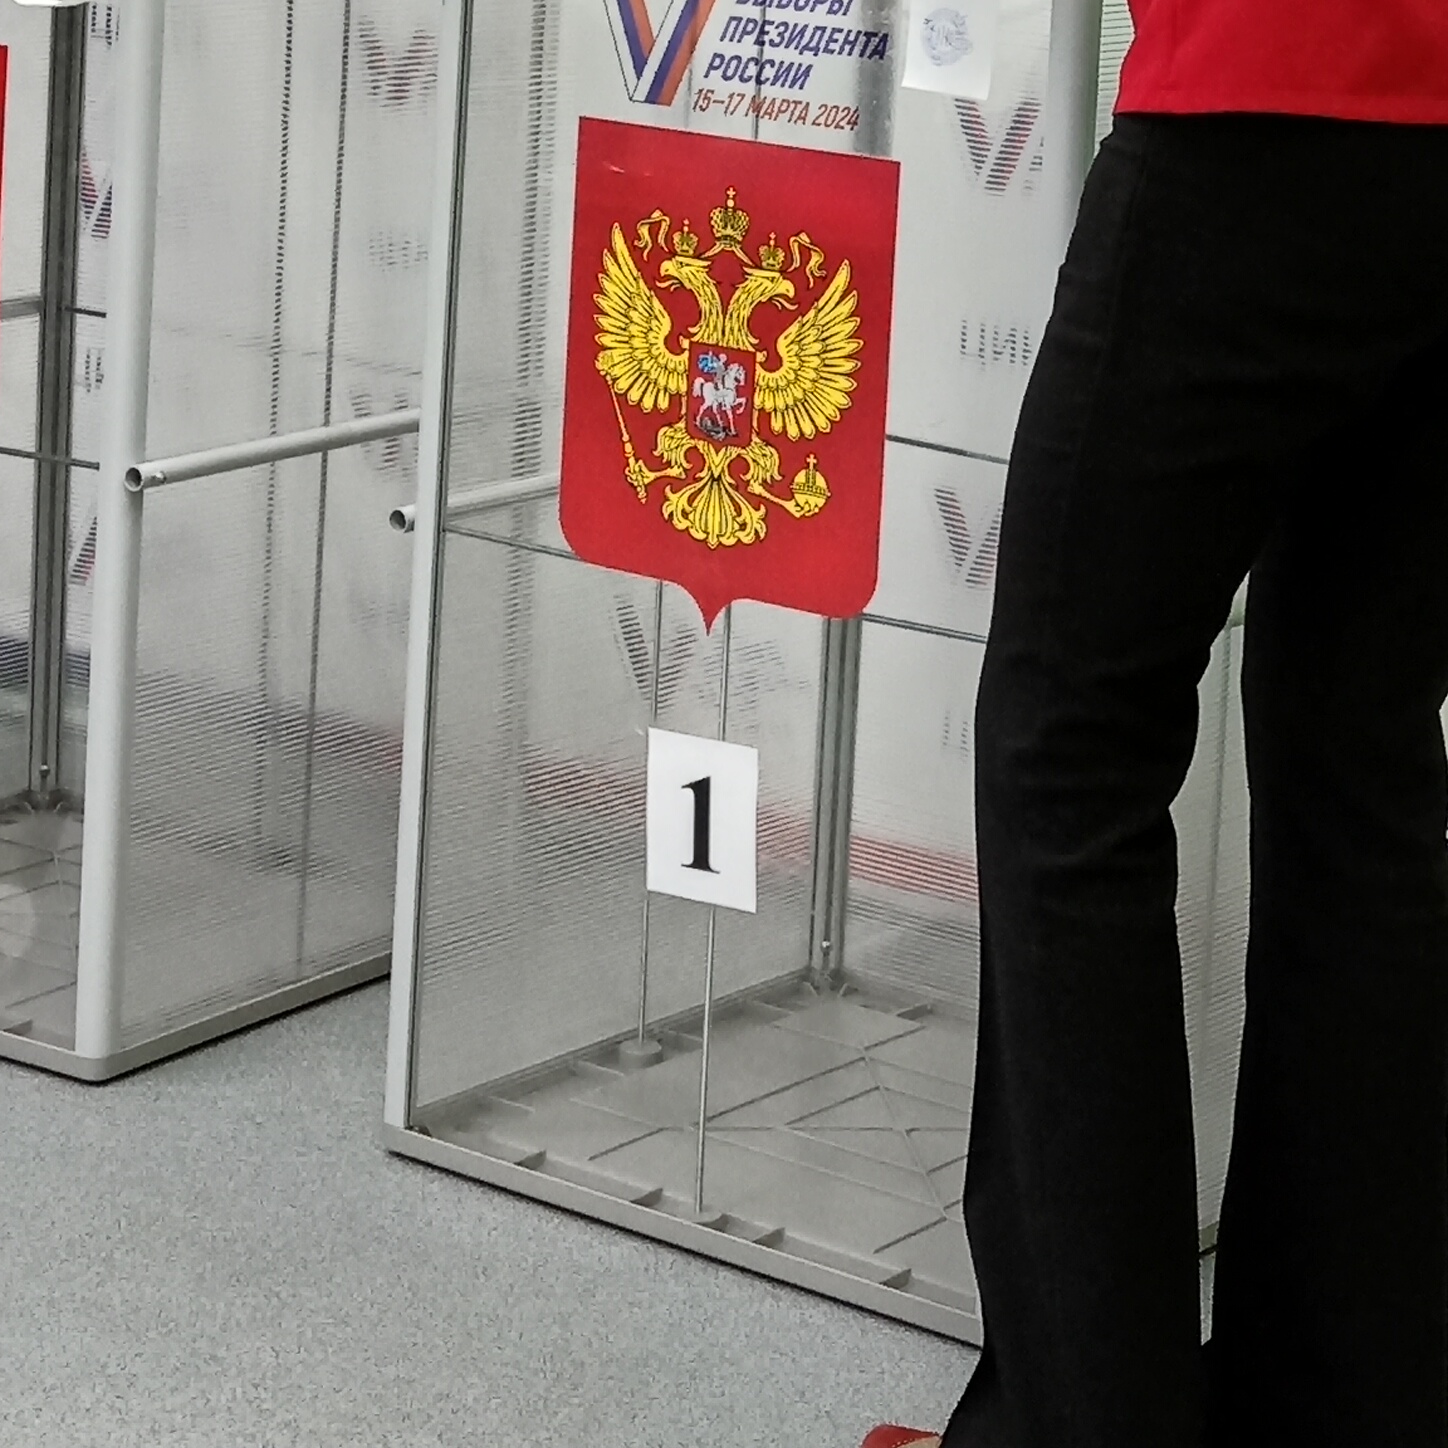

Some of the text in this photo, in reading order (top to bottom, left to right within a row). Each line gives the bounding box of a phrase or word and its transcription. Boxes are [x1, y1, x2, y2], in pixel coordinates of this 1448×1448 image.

[719, 16, 890, 61] ПРЕЗИДЕНТА
[703, 52, 813, 90] РОССИИ
[745, 94, 810, 126] МАРТА
[811, 105, 861, 131] 2024
[681, 775, 721, 874] 1
